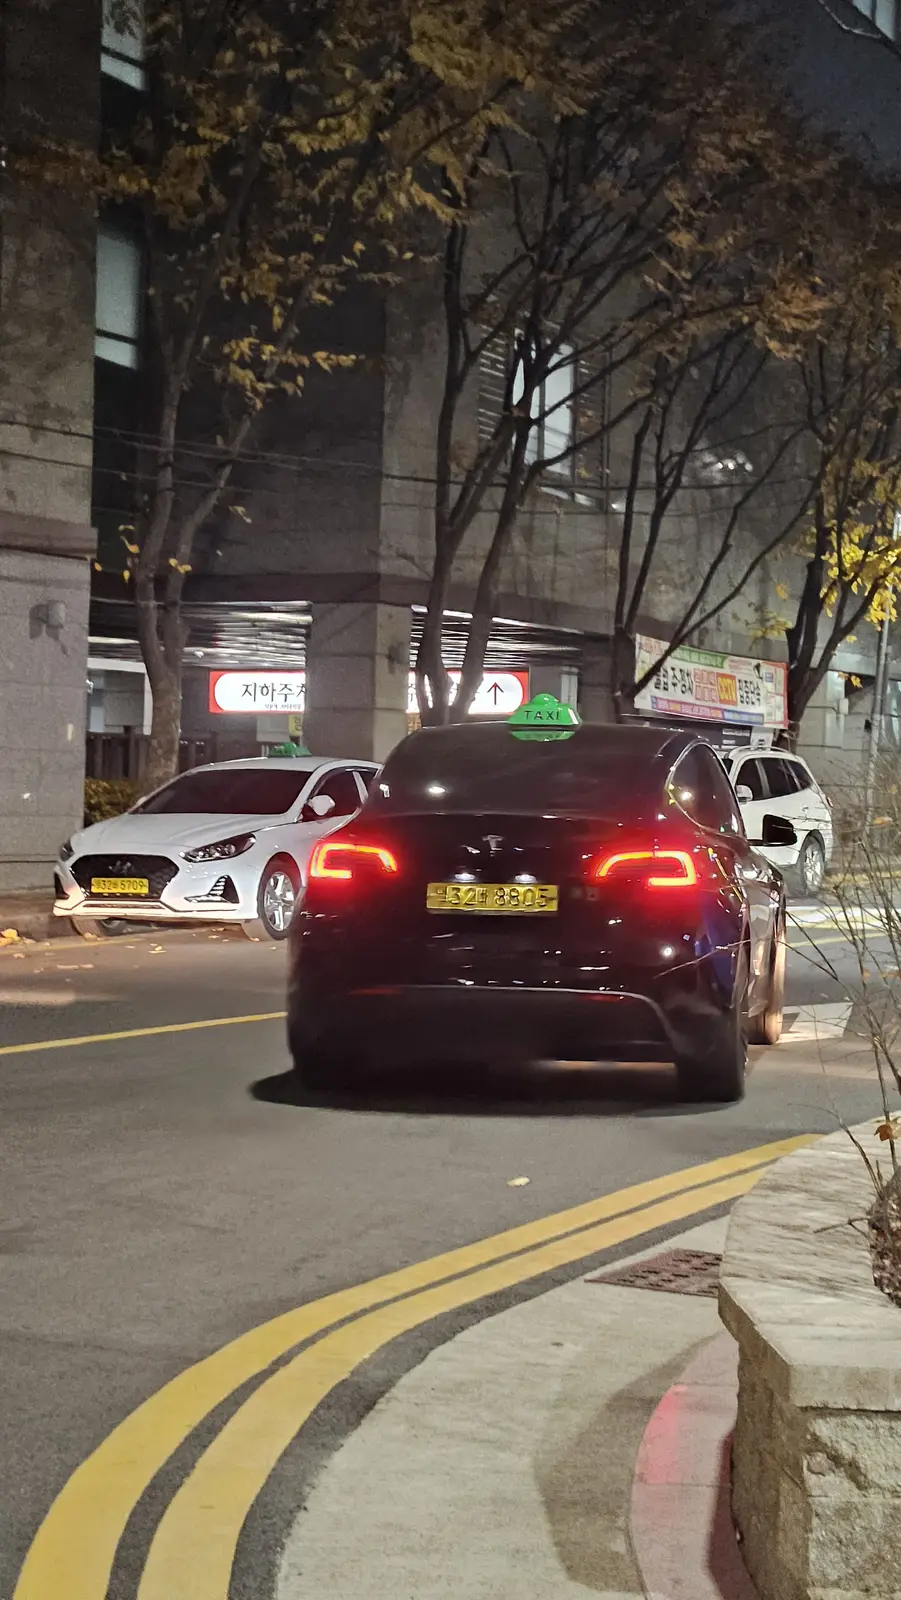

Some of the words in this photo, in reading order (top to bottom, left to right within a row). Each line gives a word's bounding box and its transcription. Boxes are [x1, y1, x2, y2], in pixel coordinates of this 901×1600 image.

[524, 710, 560, 721] TAXI
[120, 880, 145, 891] 5709
[495, 887, 549, 907] 8805
